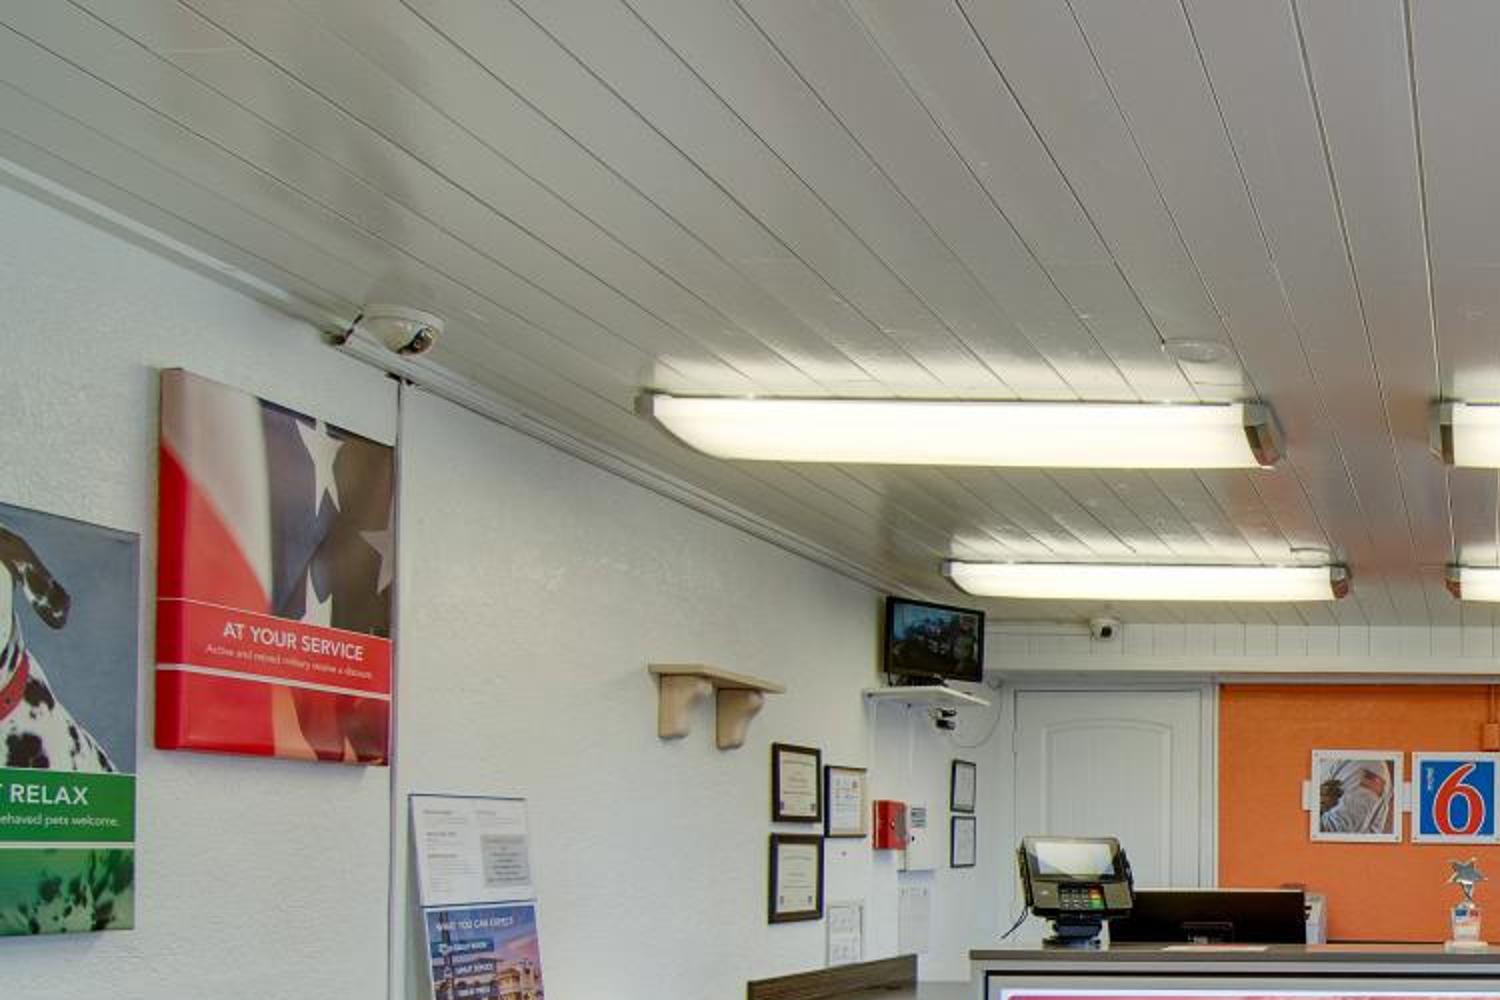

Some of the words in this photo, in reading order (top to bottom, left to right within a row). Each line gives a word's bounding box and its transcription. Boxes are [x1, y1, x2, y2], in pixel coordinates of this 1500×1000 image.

[223, 622, 245, 640] AT
[250, 626, 298, 650] YOUR
[301, 635, 364, 661] SERVICE
[9, 783, 89, 806] RELAX
[1432, 761, 1486, 836] 6
[0, 812, 43, 825] ehaved
